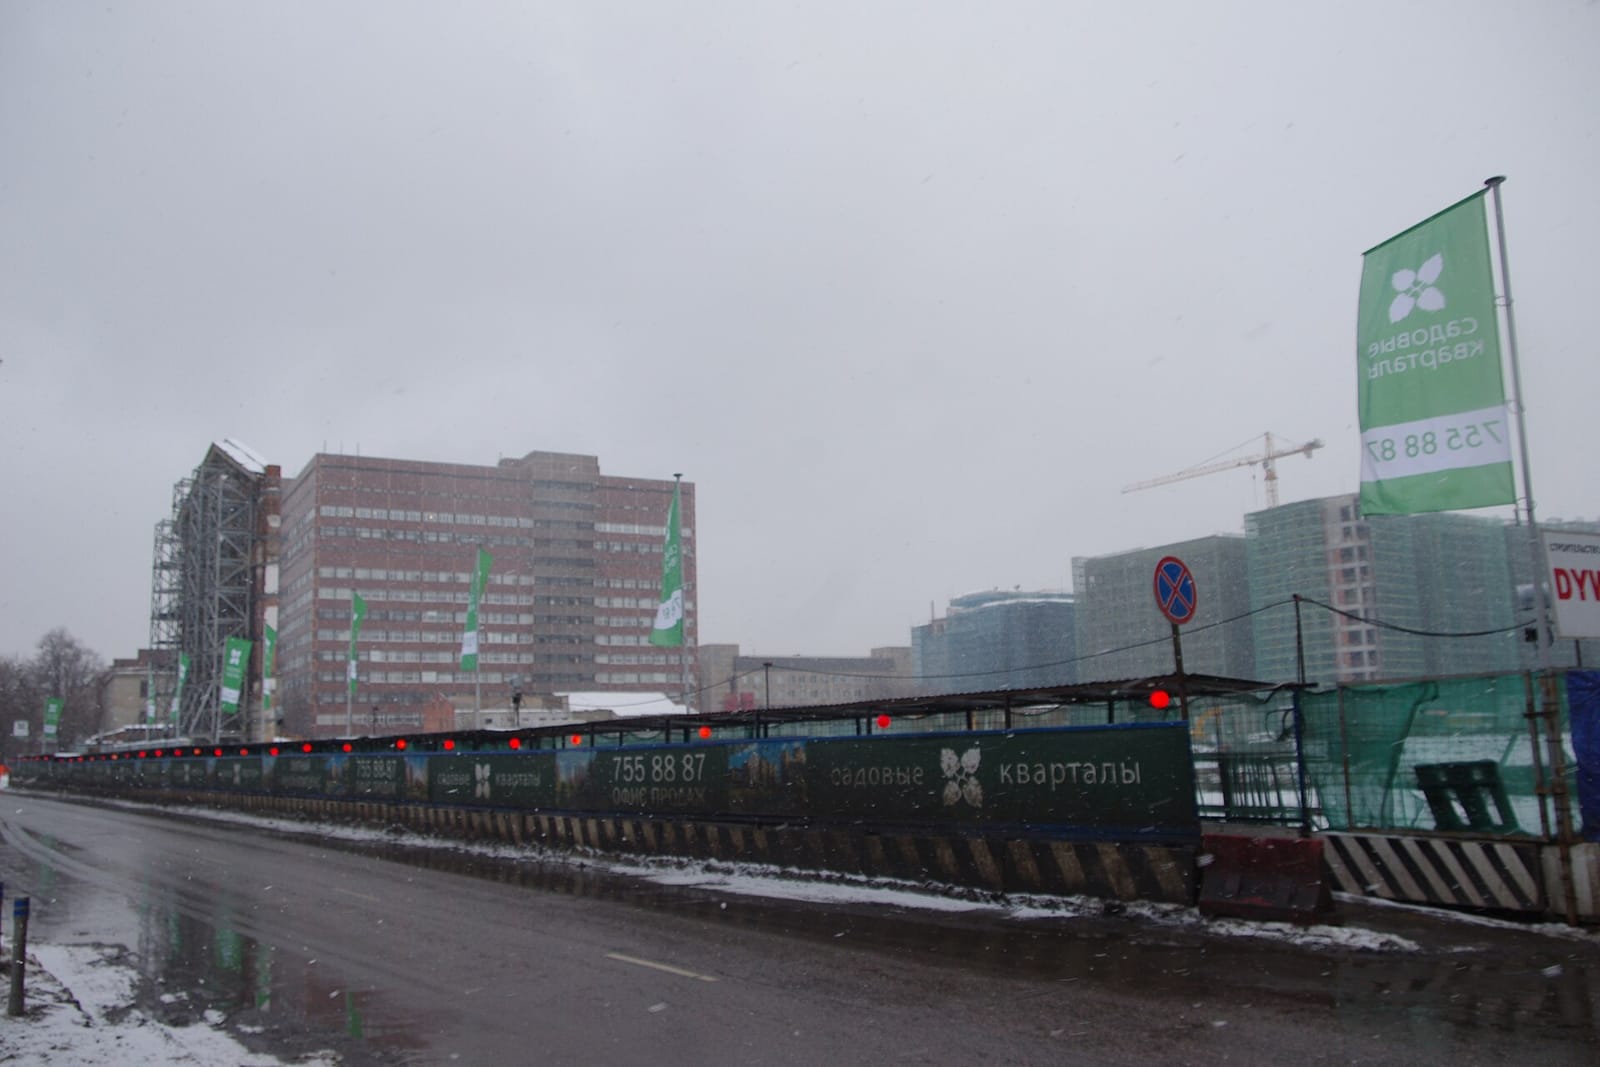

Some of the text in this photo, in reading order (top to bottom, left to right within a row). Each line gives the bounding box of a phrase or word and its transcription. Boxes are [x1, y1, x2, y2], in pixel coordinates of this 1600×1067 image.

[612, 753, 706, 782] 755 88 87
[831, 761, 1141, 791] садовые кварталы
